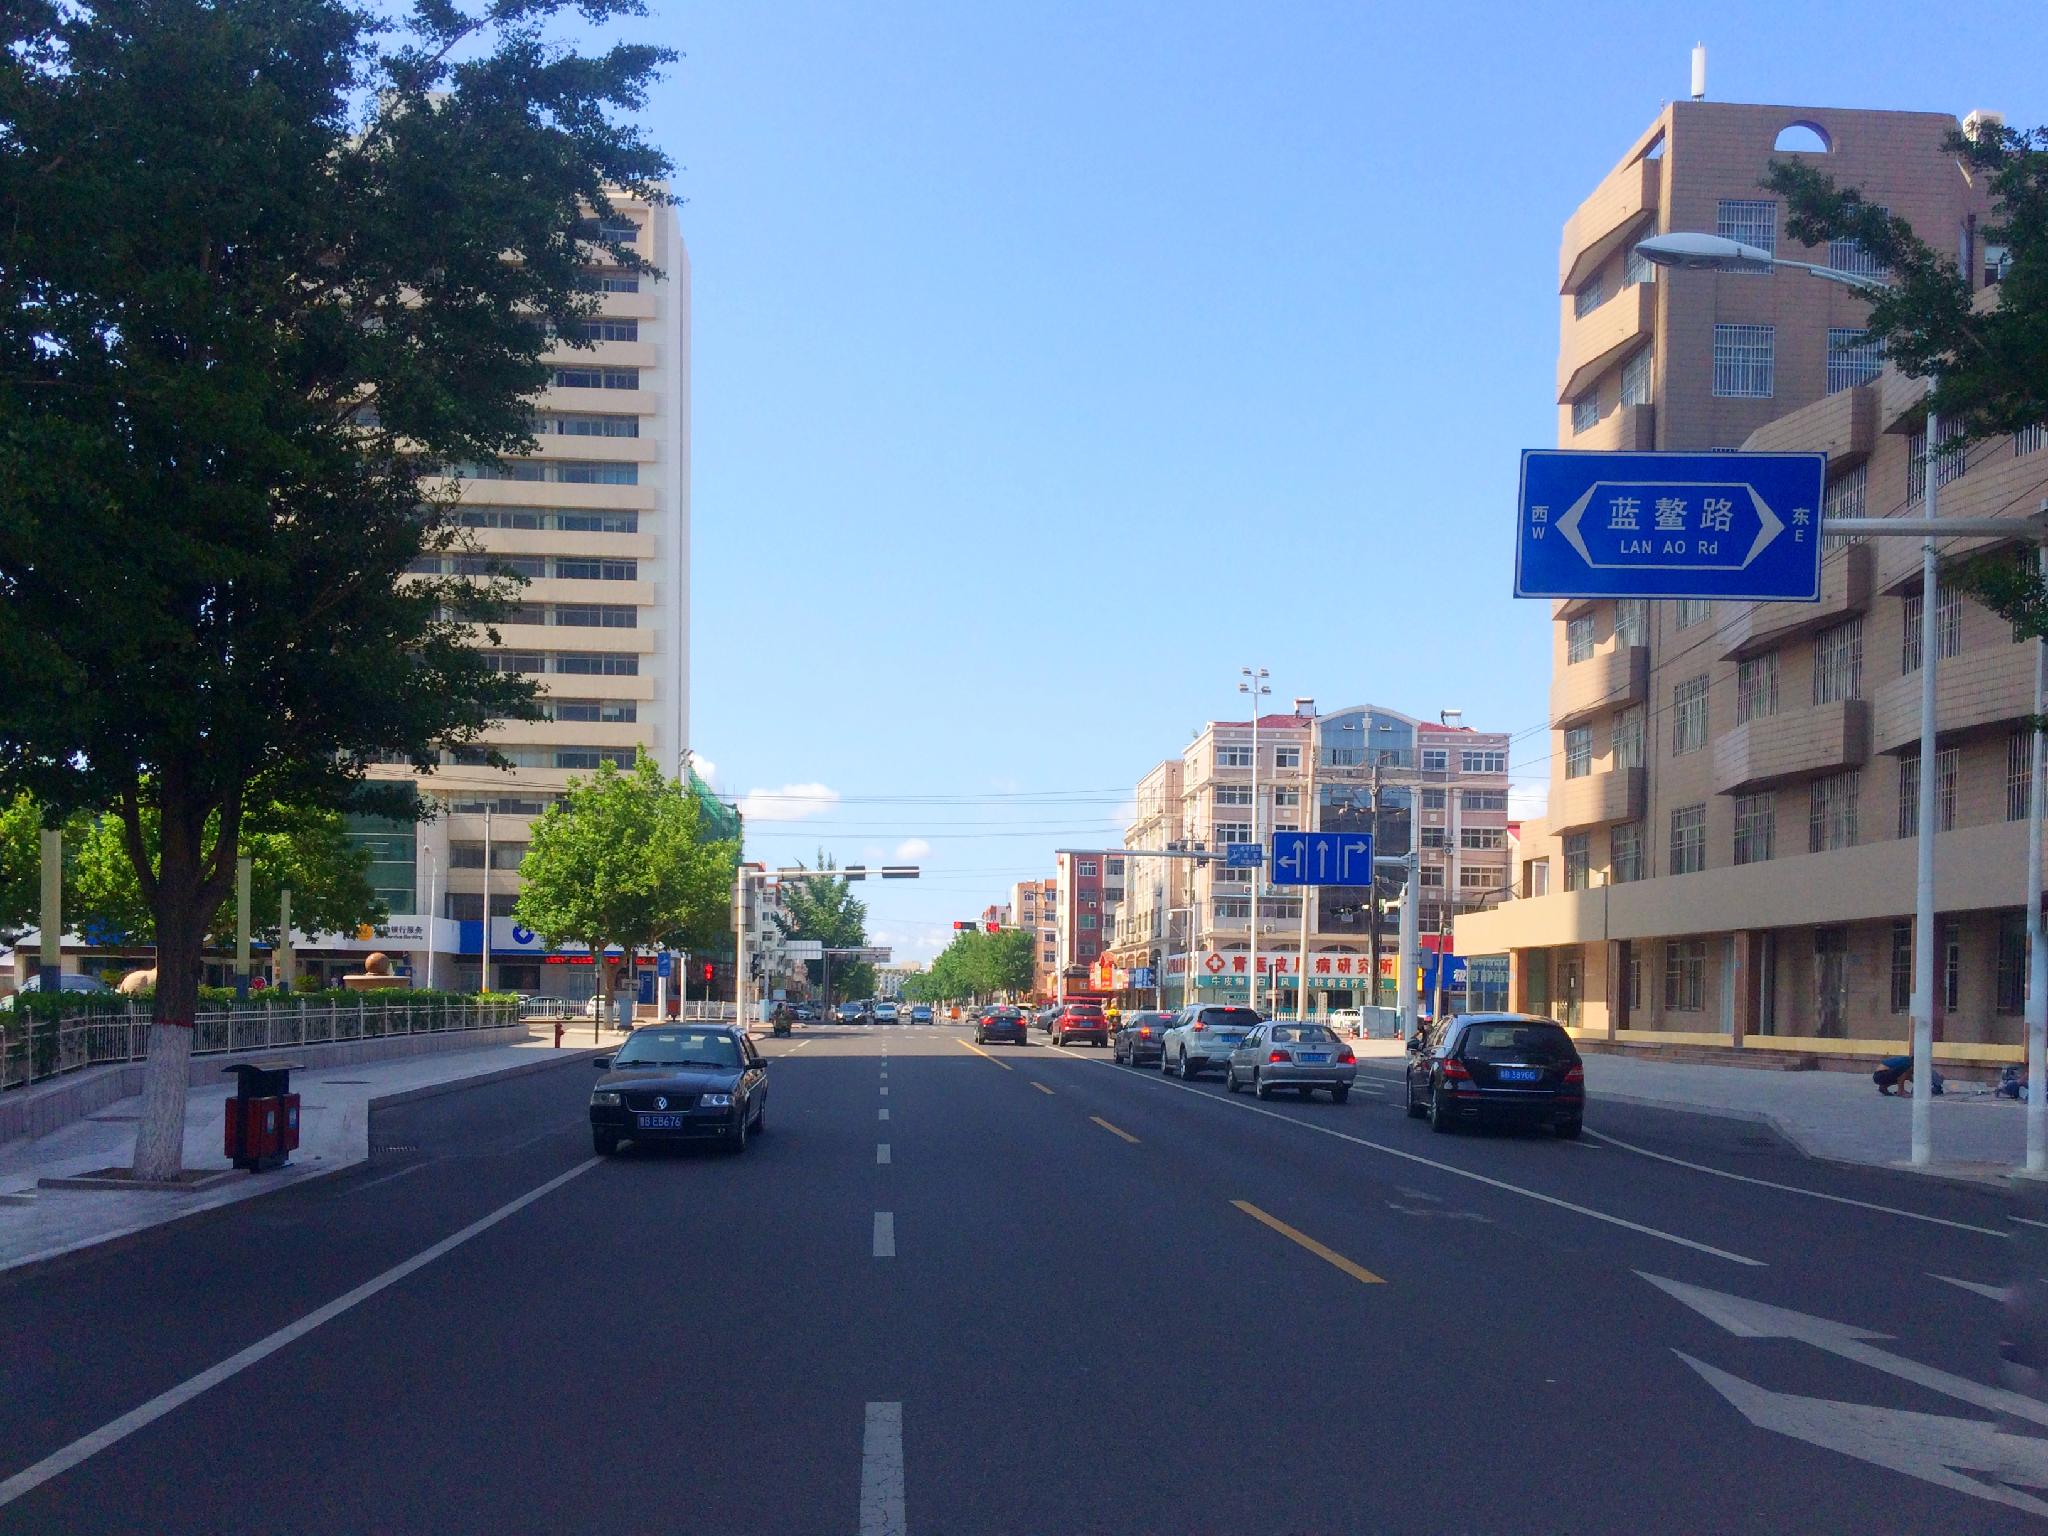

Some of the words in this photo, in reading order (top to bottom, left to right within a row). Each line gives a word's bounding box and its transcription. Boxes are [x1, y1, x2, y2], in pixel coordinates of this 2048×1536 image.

[1531, 505, 1549, 524] 西
[1607, 497, 1733, 532] 蓝鳌路
[1792, 508, 1810, 526] 东
[1532, 527, 1545, 540] W
[1795, 530, 1804, 543] E
[1620, 540, 1652, 554] LAN
[1663, 541, 1686, 554] AO
[1698, 541, 1718, 555] Rd
[375, 925, 423, 934] 助银行服务
